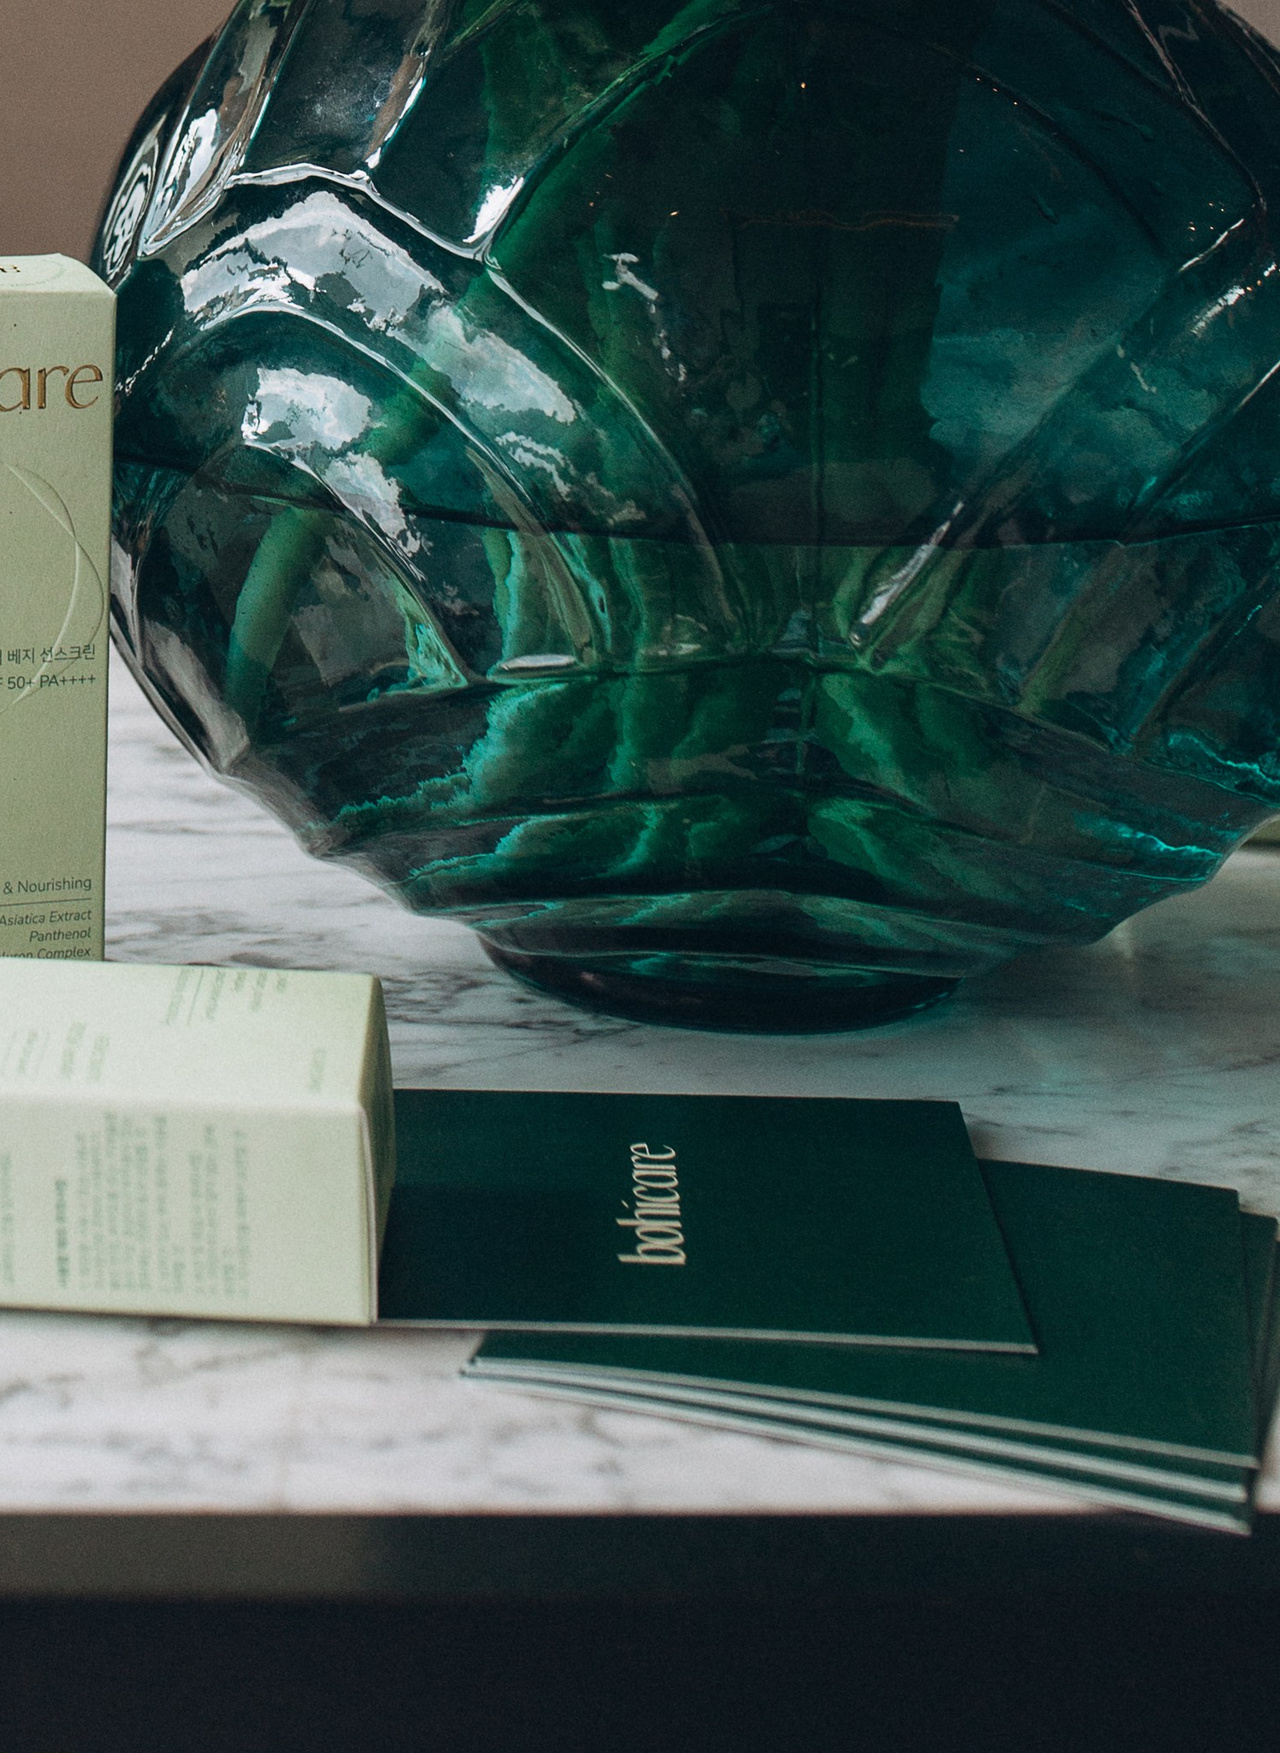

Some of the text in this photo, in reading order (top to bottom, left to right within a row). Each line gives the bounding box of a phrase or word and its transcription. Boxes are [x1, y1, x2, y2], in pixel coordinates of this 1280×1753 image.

[7, 647, 35, 664] 베지
[39, 644, 96, 664] 선스크린
[7, 675, 35, 690] 50+
[39, 674, 96, 688] PA++++
[2, 881, 13, 895] &
[17, 877, 92, 894] Nourishing
[49, 910, 92, 923] Extract
[29, 927, 91, 943] Panthenol
[37, 947, 92, 960] Complex
